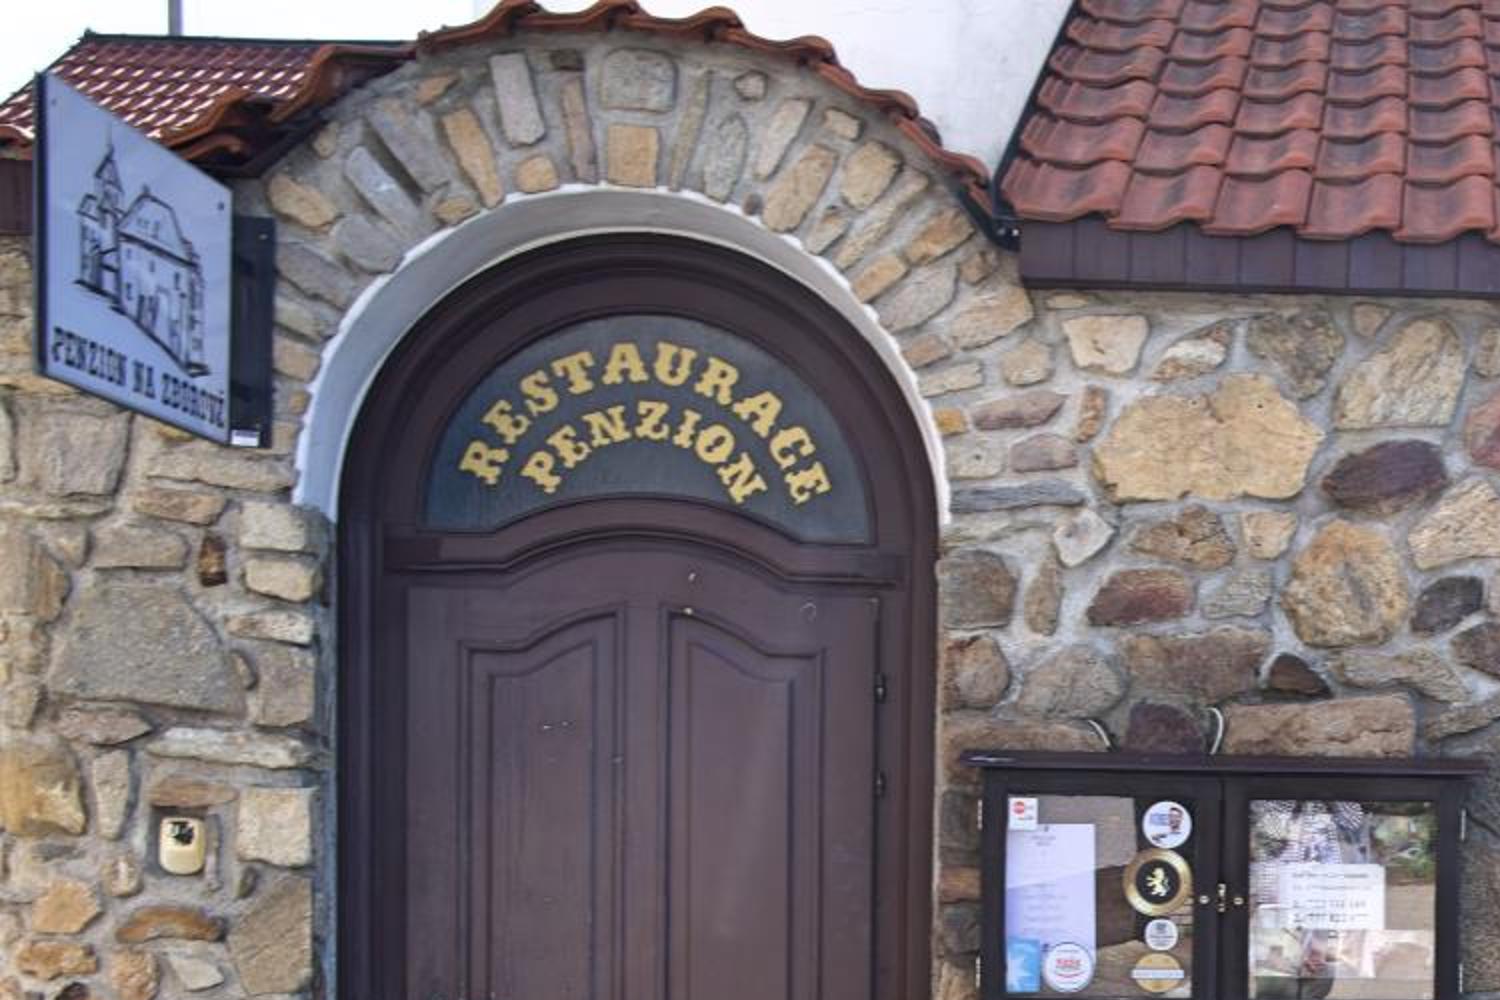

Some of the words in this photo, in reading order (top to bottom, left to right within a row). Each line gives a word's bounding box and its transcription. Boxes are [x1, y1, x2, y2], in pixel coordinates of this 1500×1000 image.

[52, 325, 127, 386] PENZION
[132, 358, 156, 399] NA
[458, 341, 832, 506] RESTAURACE
[520, 400, 768, 504] PENZION
